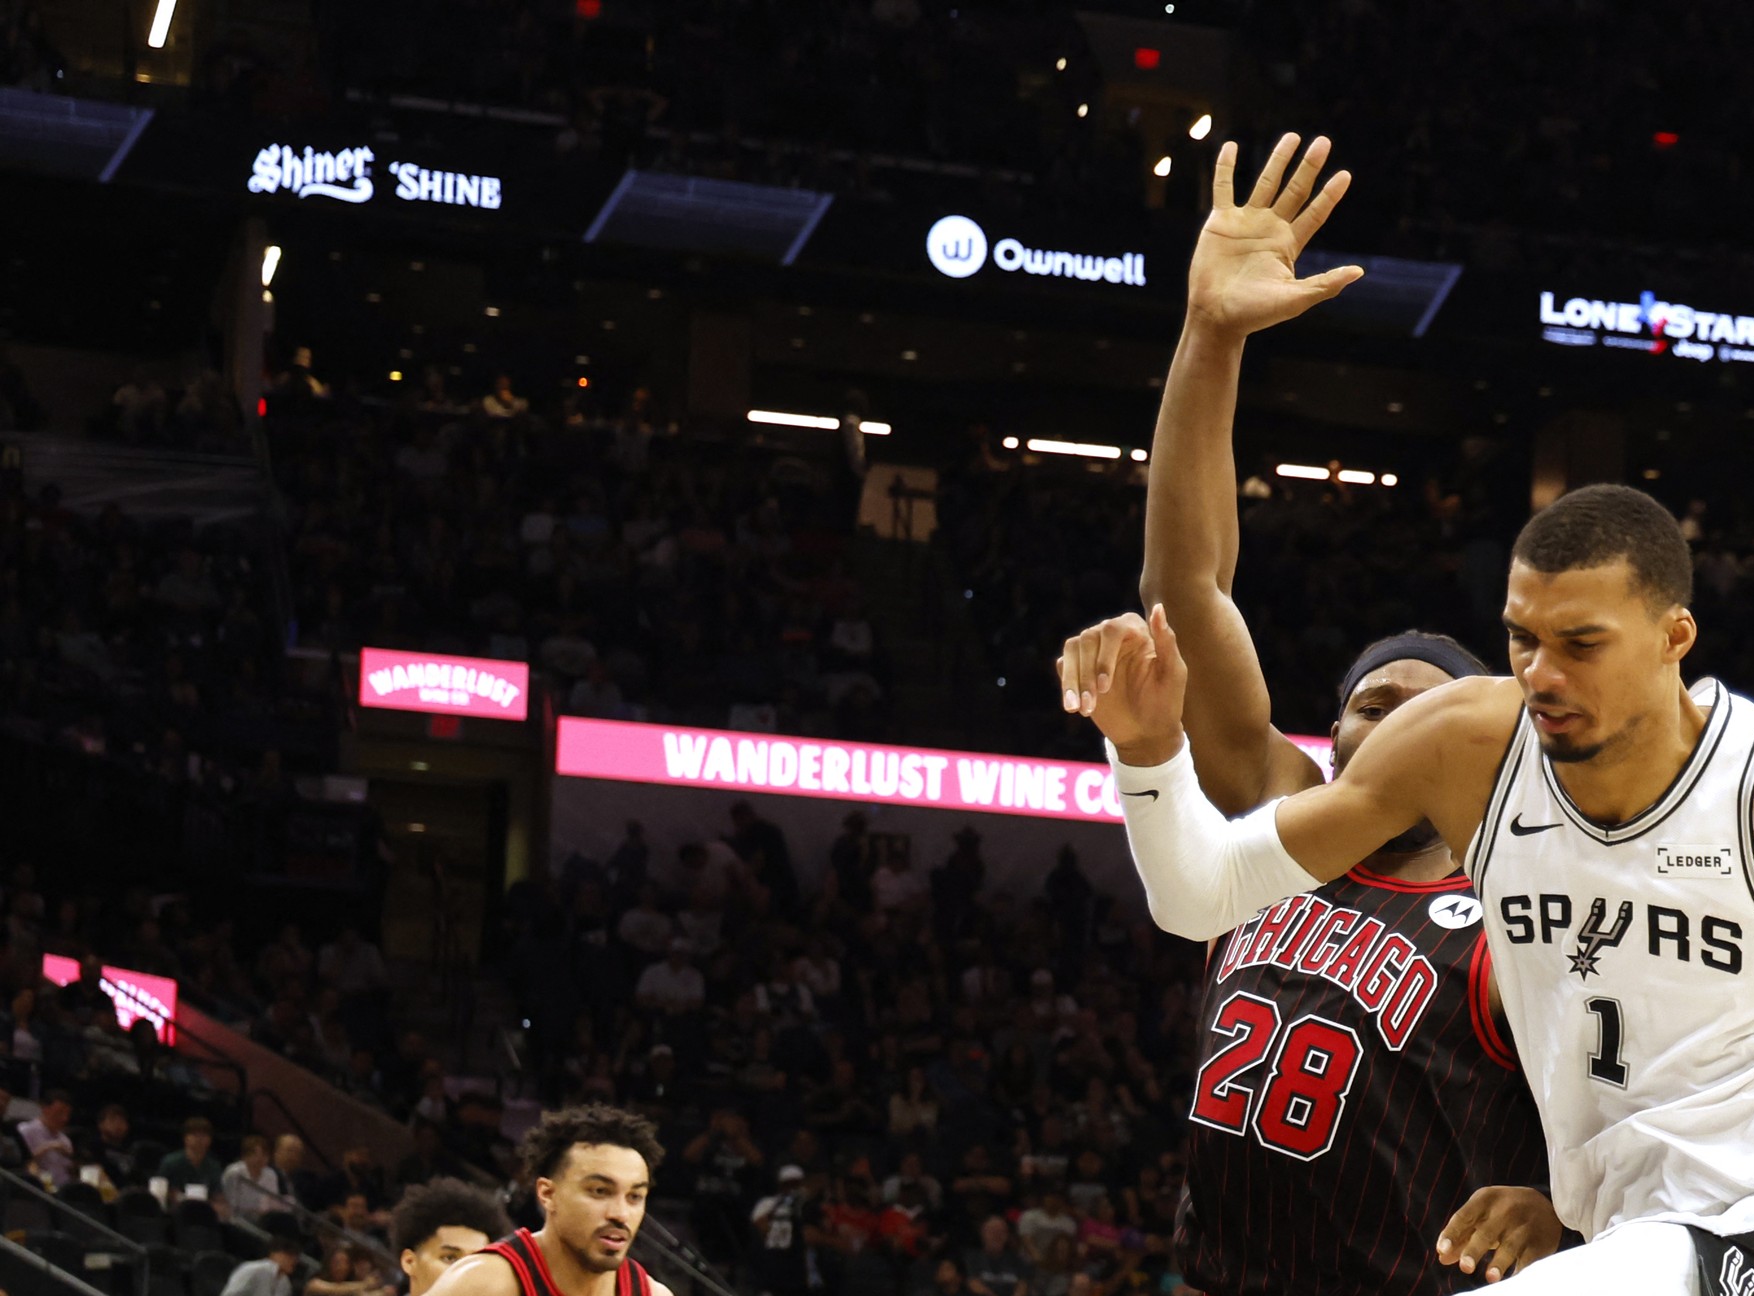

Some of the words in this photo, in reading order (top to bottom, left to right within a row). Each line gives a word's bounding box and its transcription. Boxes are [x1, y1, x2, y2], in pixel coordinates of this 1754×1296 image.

[247, 143, 374, 203] Shiner
[993, 238, 1147, 286] Ownwell
[1540, 291, 1643, 334] LONE
[663, 732, 947, 801] WANDERLUST
[958, 757, 1067, 813] WINE
[1666, 855, 1723, 868] LEDGER
[1500, 893, 1744, 983] SPURS
[1189, 990, 1364, 1162] 28
[1583, 995, 1631, 1092] 1
